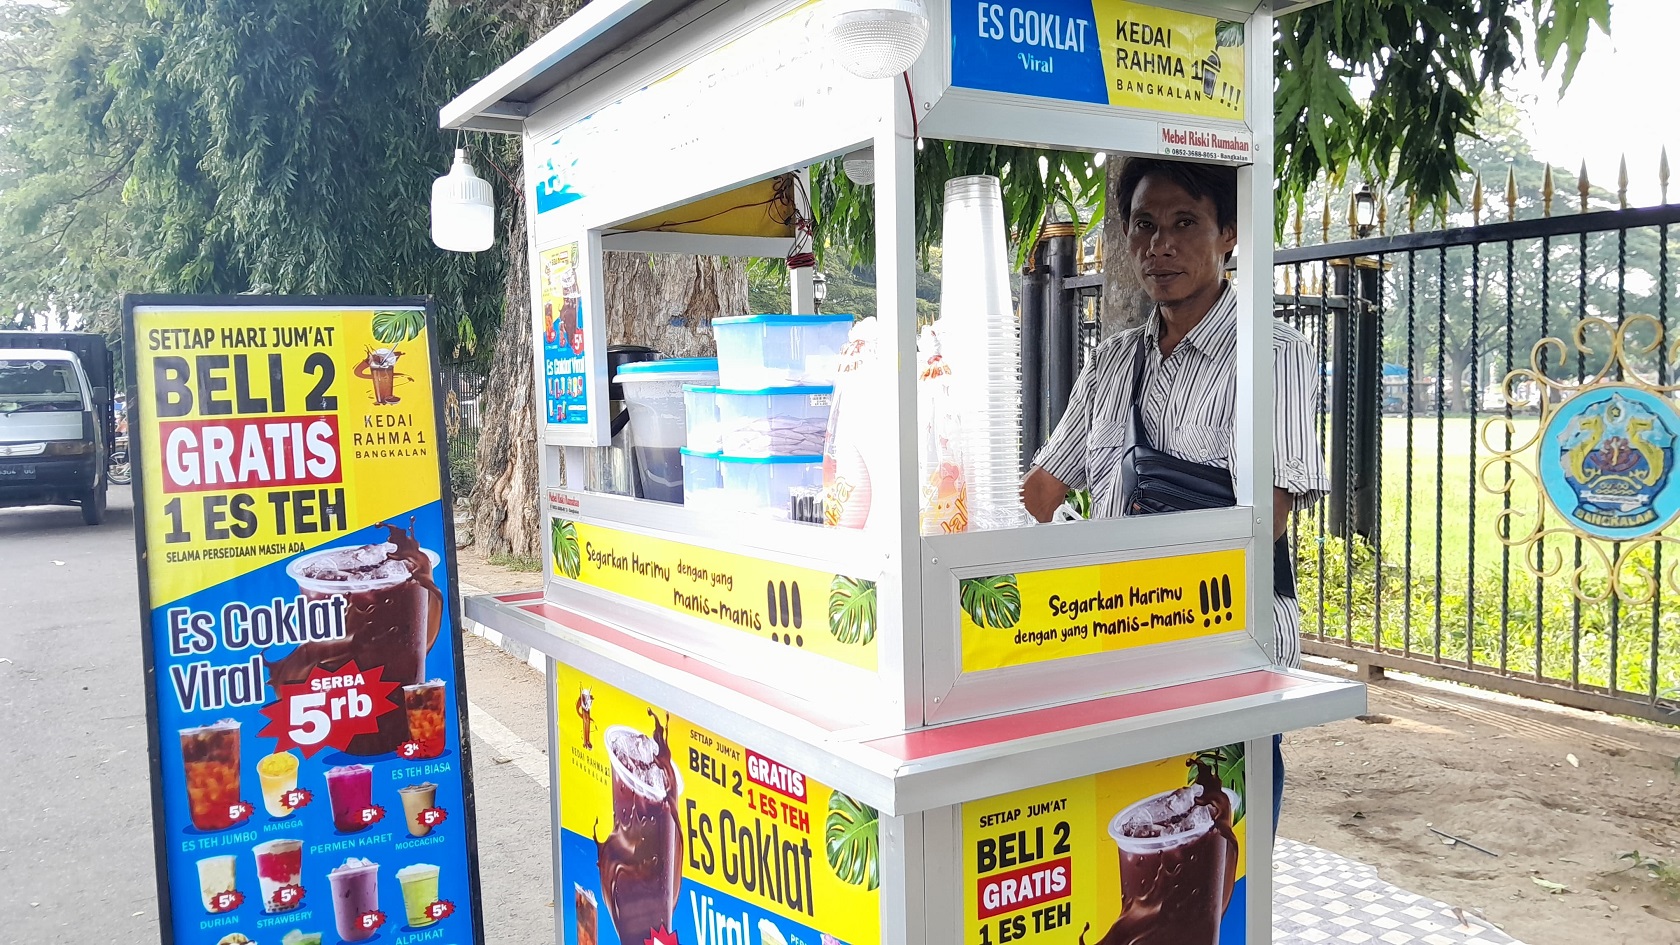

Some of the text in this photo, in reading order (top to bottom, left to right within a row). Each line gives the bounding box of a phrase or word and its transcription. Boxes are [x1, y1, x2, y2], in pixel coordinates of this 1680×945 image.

[978, 1, 1088, 53] ES COKLAT
[1116, 19, 1171, 49] KEDAI
[1017, 52, 1053, 73] Viral
[1116, 48, 1185, 78] RAHMA
[1116, 79, 1201, 101] BANGKALAN
[1162, 128, 1249, 151] Mebel Riski Rumahan
[149, 326, 335, 350] SETIAP HARI JUM'AT
[154, 352, 338, 418] BELI 2
[364, 414, 413, 428] KEDAI
[165, 420, 337, 487] GRATIS
[353, 432, 426, 446] RAHMA 1
[354, 448, 428, 459] BANGKALAN
[164, 488, 347, 543] 1 ES TEH
[166, 542, 306, 563] SELAMA PERSEDIAAN MASIH ADA
[586, 541, 733, 591] Segarkan Harimu dengan yang
[673, 588, 762, 631] manis-manis
[1048, 586, 1183, 620] Segarkan Harimu
[168, 594, 347, 656] Es Coklat
[1014, 608, 1195, 645] dengan yang manis-manis
[170, 656, 264, 712] Viral
[310, 674, 365, 691] SERBA
[288, 689, 372, 745] 5rb
[690, 729, 741, 762] SETIAP JUM'AT
[391, 762, 451, 780] ES TEH BIASA
[689, 746, 743, 797] BELI 2
[747, 755, 805, 798] GRATIS
[263, 820, 303, 832] MANGGA
[748, 788, 810, 834] 1 ES TEH
[979, 799, 1067, 828] SETIAP JUM'AT
[181, 831, 258, 852] ES TEH JUMBO
[310, 833, 393, 855] PERMEN KARET
[395, 836, 445, 850] MOCCACINO
[977, 821, 1071, 874] BELI 2
[685, 799, 814, 917] Es Coklat
[983, 866, 1067, 911] GRATIS
[200, 915, 239, 930] DURIAN
[256, 911, 312, 929] STRAWBERY
[979, 902, 1071, 945] 1 ES TEH
[395, 928, 445, 945] ALPUKAT
